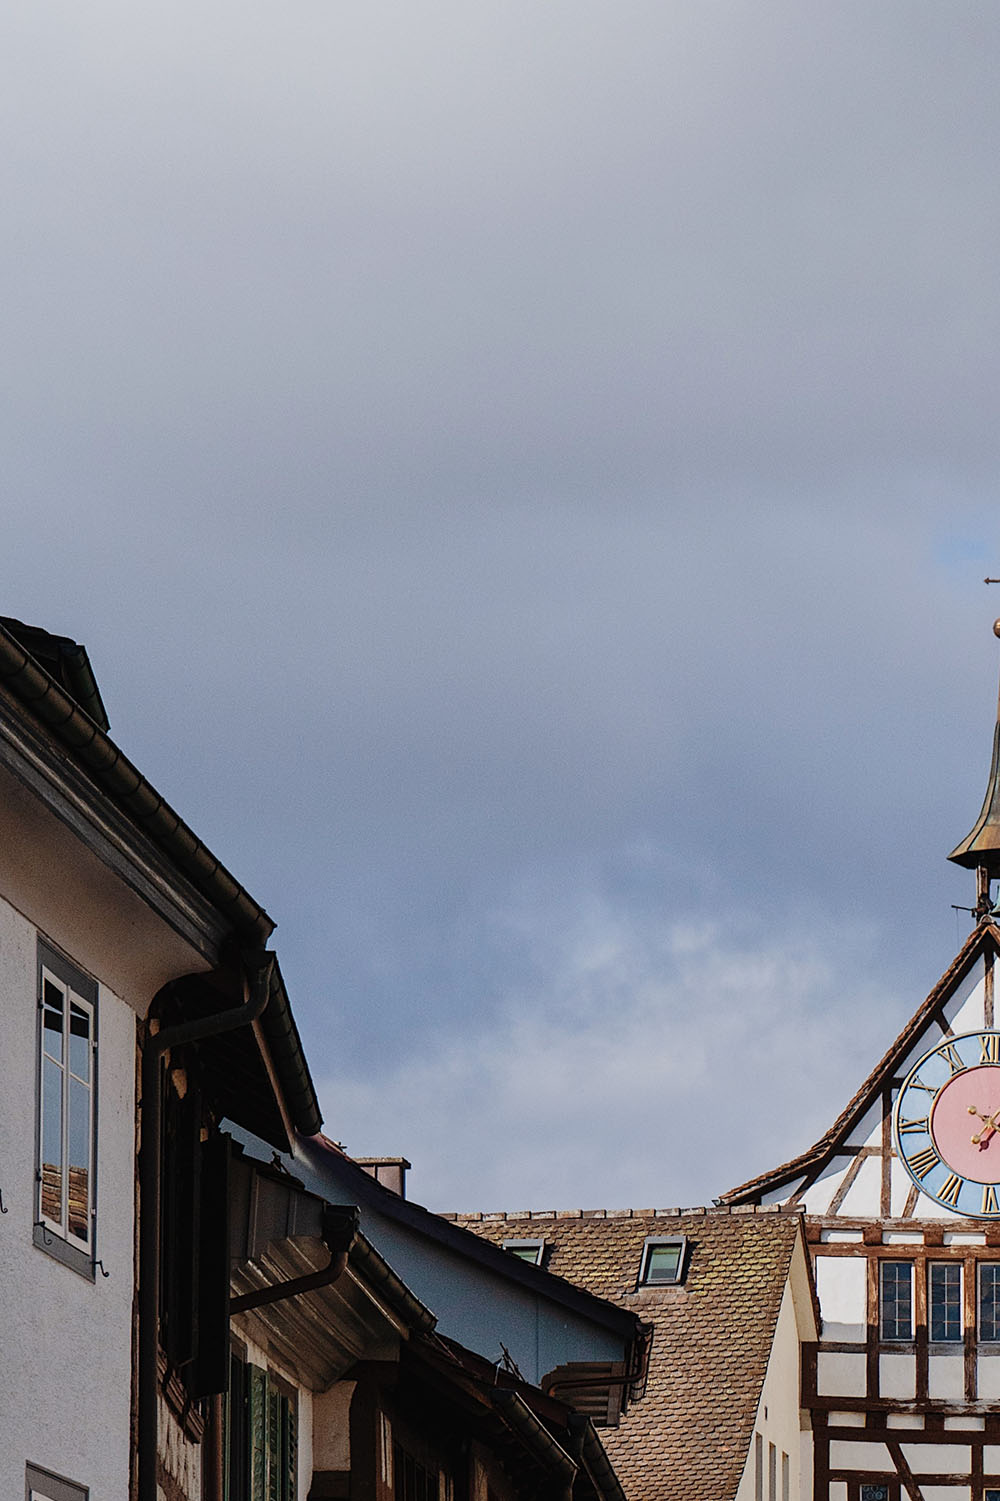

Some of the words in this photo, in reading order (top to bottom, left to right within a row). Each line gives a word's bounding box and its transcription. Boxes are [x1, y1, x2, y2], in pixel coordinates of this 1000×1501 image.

[938, 1044, 967, 1076] XI
[910, 1075, 939, 1097] X
[899, 1117, 928, 1134] IX
[907, 1146, 940, 1181] VIII
[936, 1173, 964, 1208] VII
[982, 1186, 1000, 1214] VI
